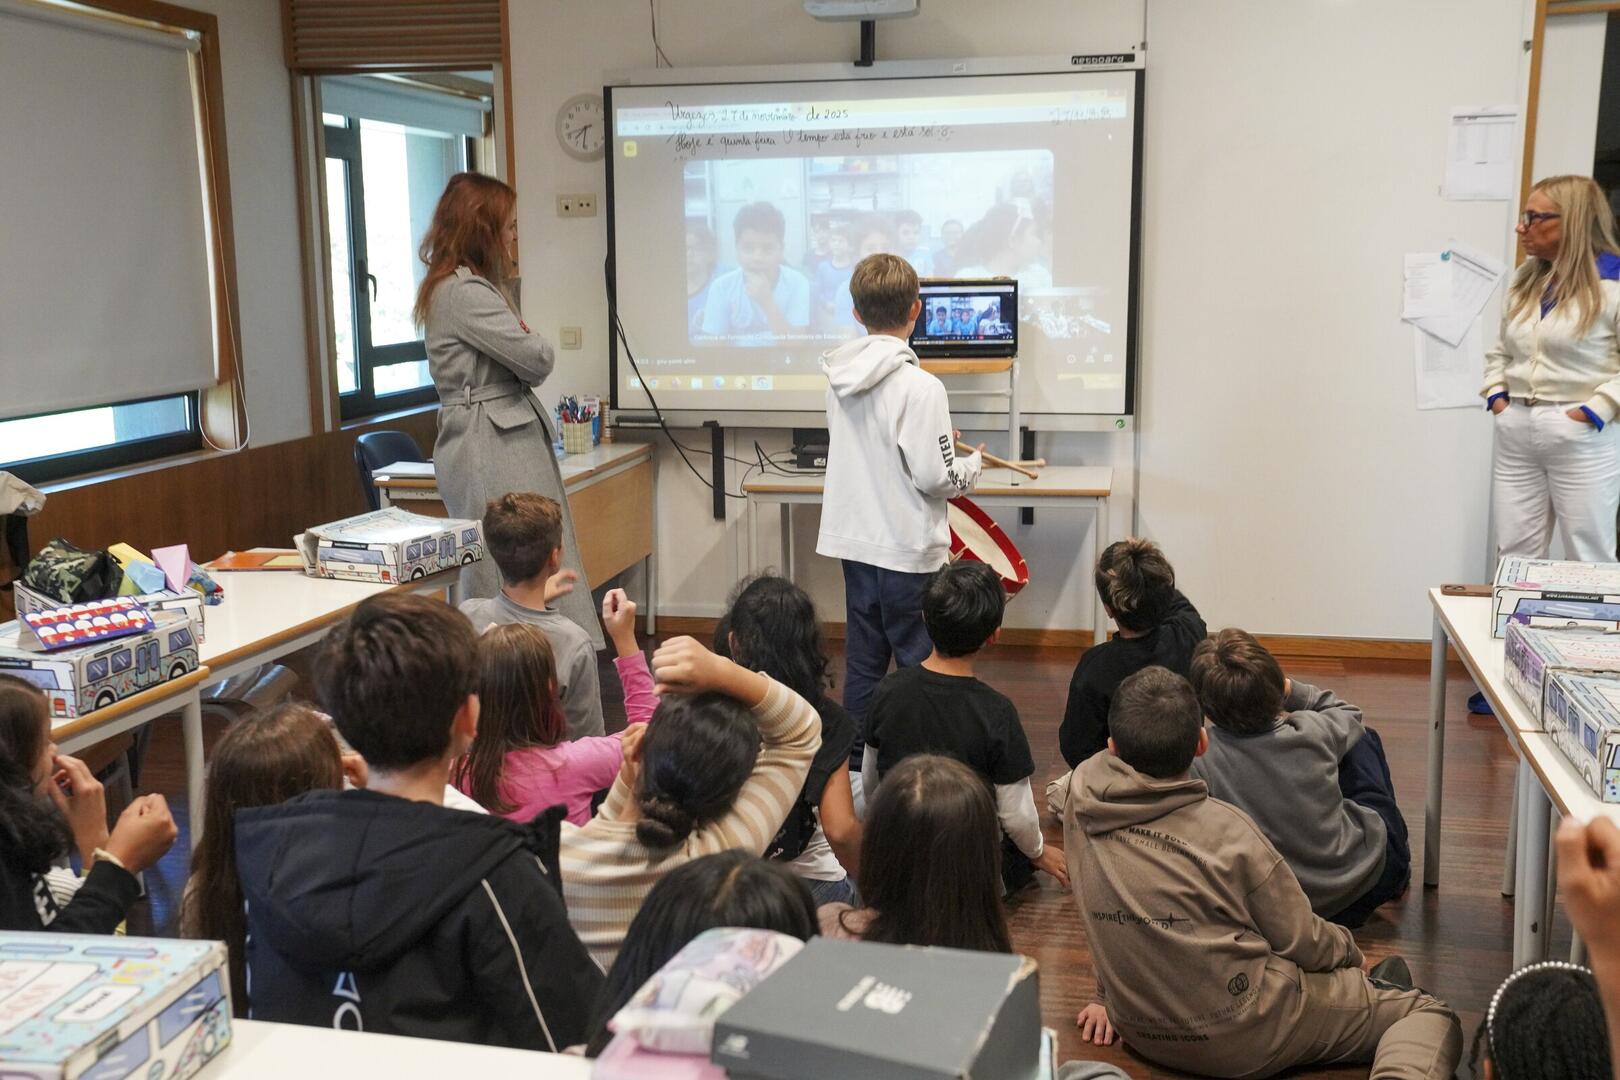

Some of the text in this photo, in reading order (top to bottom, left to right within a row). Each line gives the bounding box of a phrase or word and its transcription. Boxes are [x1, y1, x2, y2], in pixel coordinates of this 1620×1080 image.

[806, 106, 820, 121] de
[824, 108, 848, 120] 2025
[1153, 831, 1162, 839] IT
